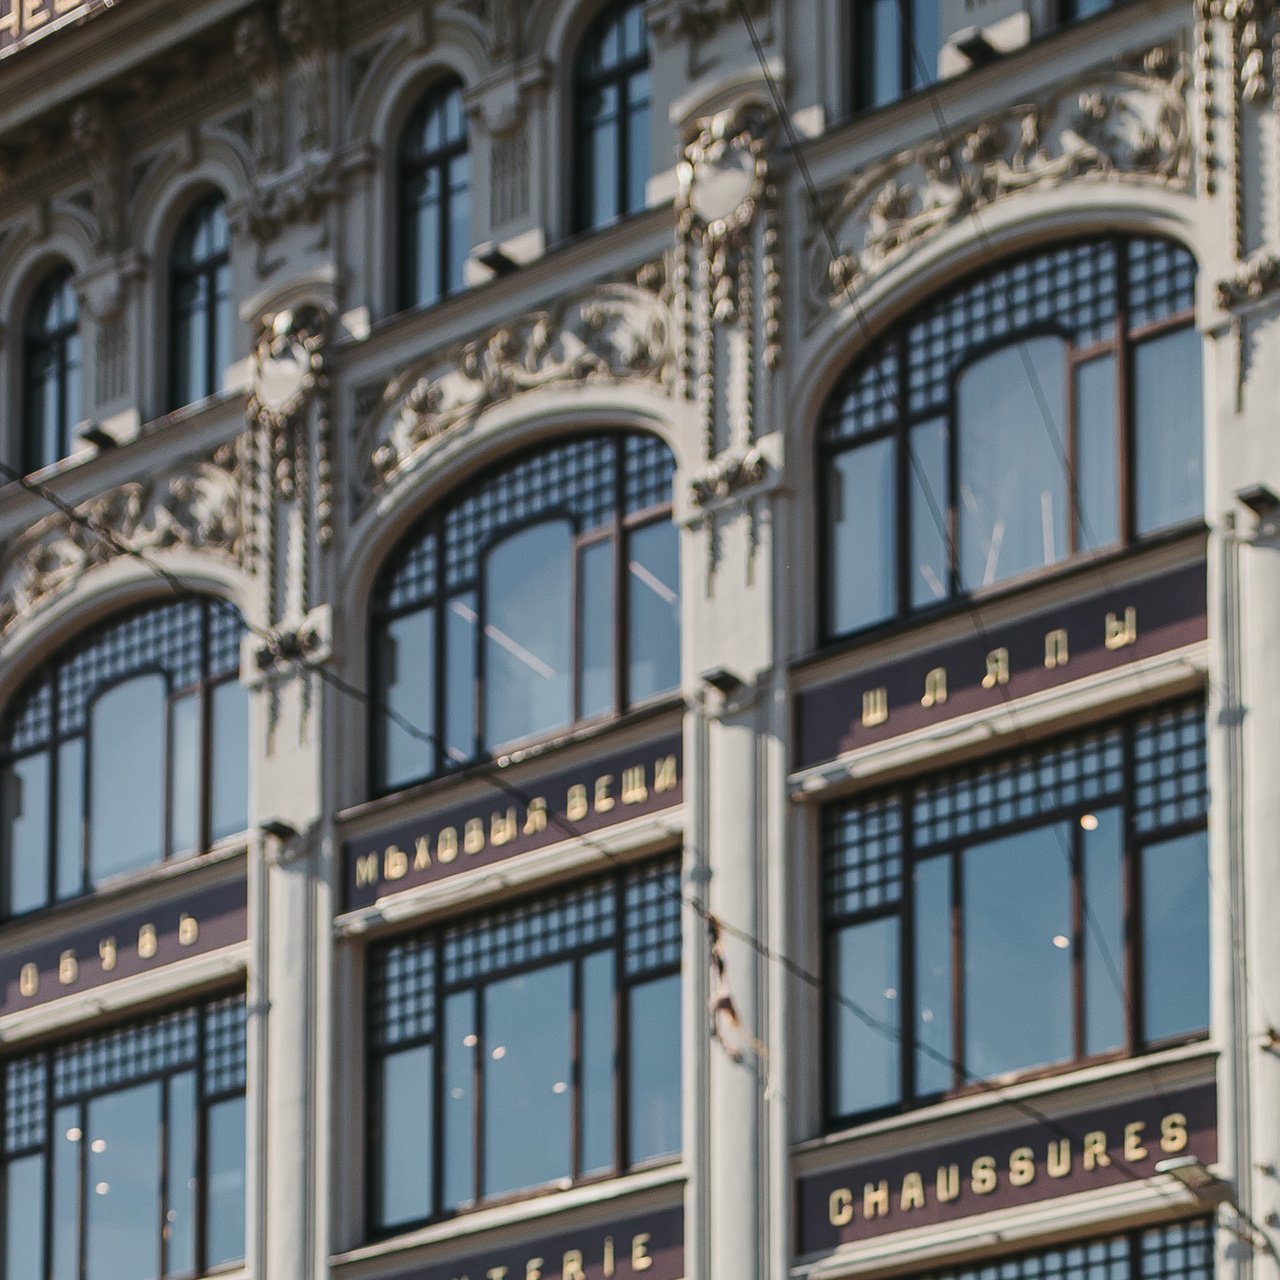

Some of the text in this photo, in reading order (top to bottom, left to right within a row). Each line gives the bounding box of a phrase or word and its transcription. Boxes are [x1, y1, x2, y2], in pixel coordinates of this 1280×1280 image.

[862, 605, 1137, 728] ШЛЯПЫ
[20, 911, 198, 998] ОБУВЬ
[829, 1112, 1188, 1227] CHAUSSURES
